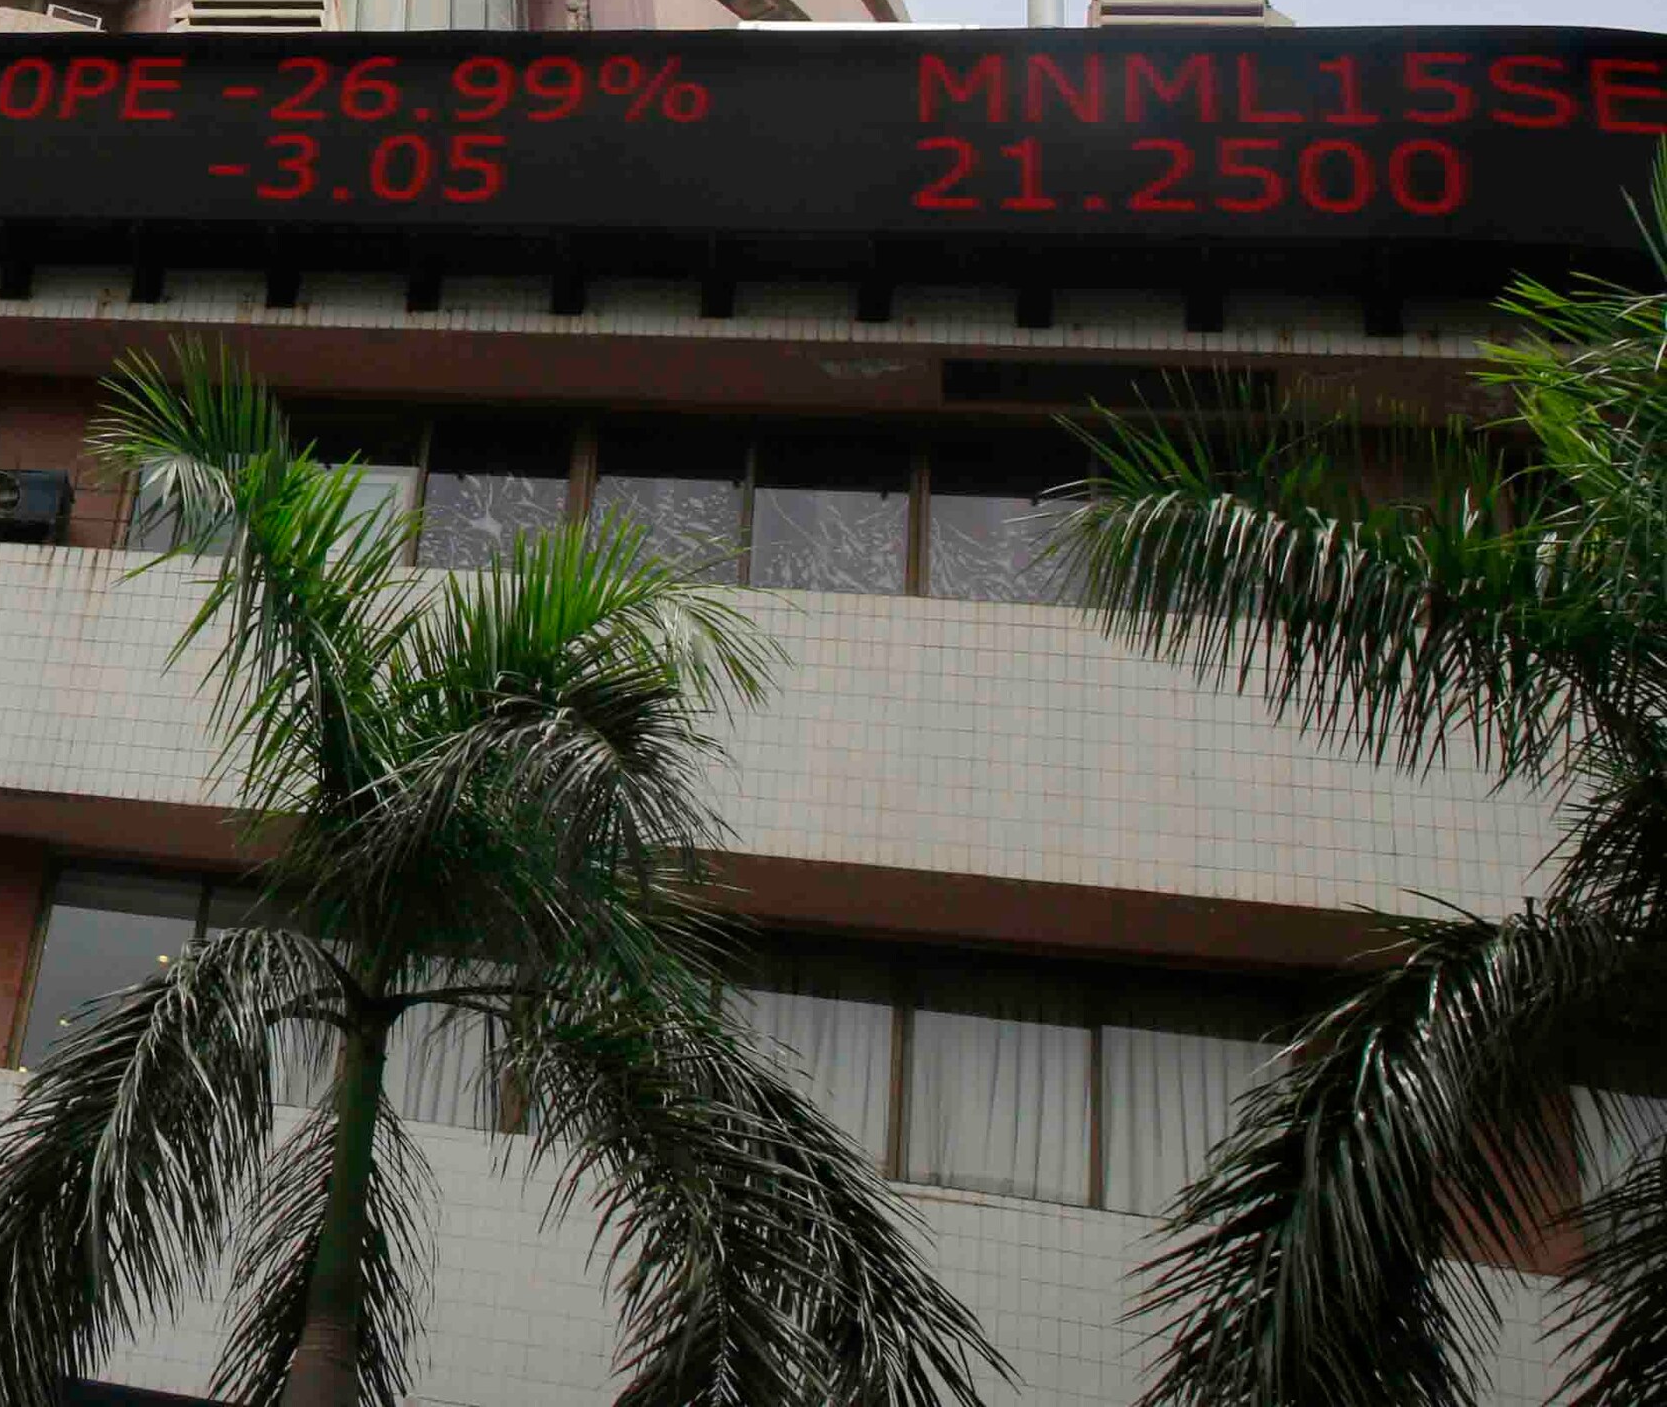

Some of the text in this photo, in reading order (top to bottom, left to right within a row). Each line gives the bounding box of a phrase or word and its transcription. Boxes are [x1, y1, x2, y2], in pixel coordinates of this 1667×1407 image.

[221, 55, 711, 123] -26.99%
[915, 51, 1667, 135] MNML15SE
[208, 132, 511, 203] -3.05
[912, 135, 1468, 215] 21.2500
